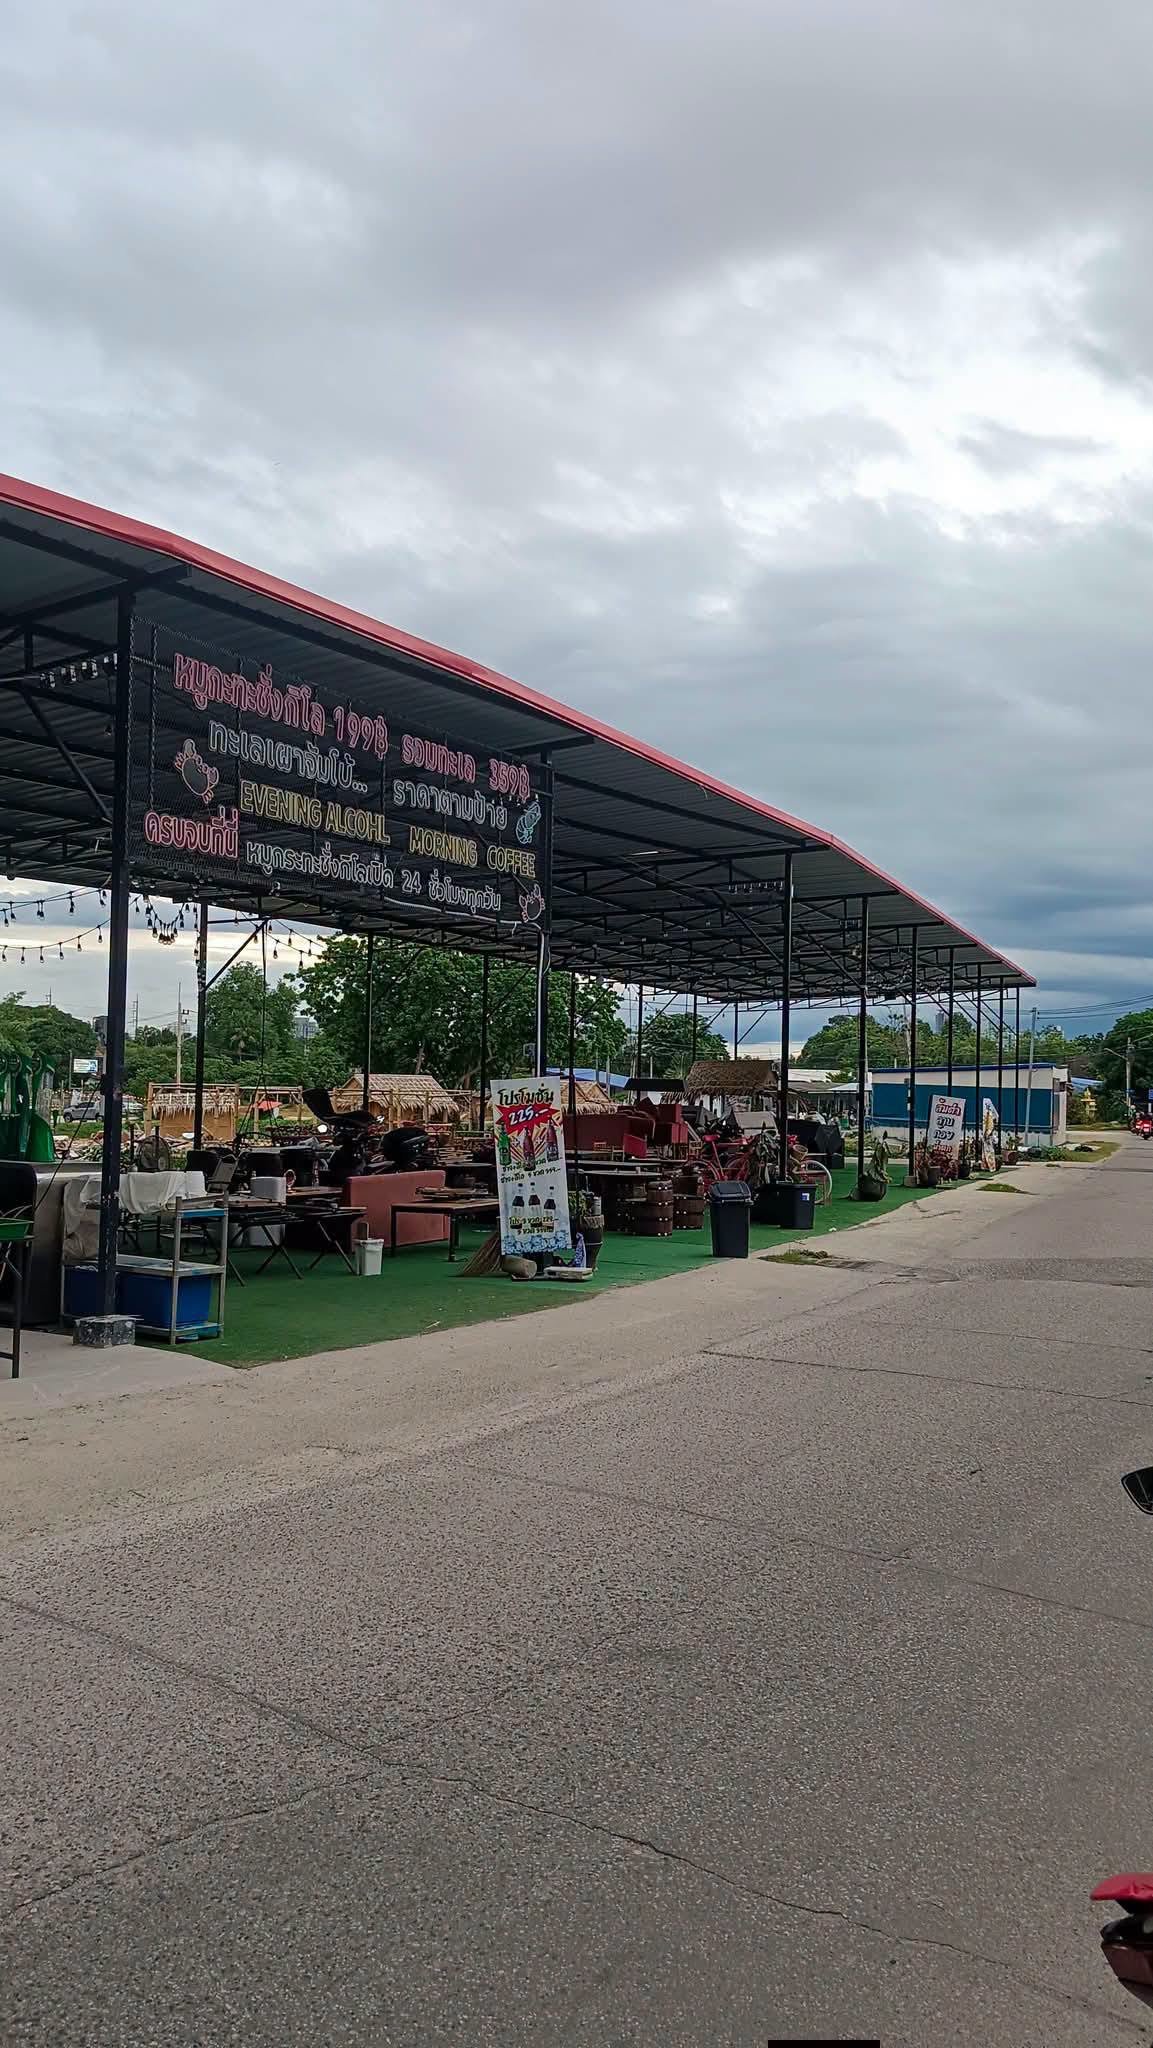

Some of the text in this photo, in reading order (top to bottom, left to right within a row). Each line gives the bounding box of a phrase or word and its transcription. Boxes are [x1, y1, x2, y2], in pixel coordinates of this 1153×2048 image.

[401, 734, 476, 784] รวมทะเล
[240, 780, 536, 879] EVENING ALCOHL MORNING COFFEE
[393, 779, 507, 830] ราคาตามป้าย
[145, 804, 239, 859] ครบจบที่นี่
[401, 870, 422, 894] 24
[429, 869, 501, 913] ชั่วโมงทุกวัน
[497, 1083, 554, 1105] โปรโมชั่น
